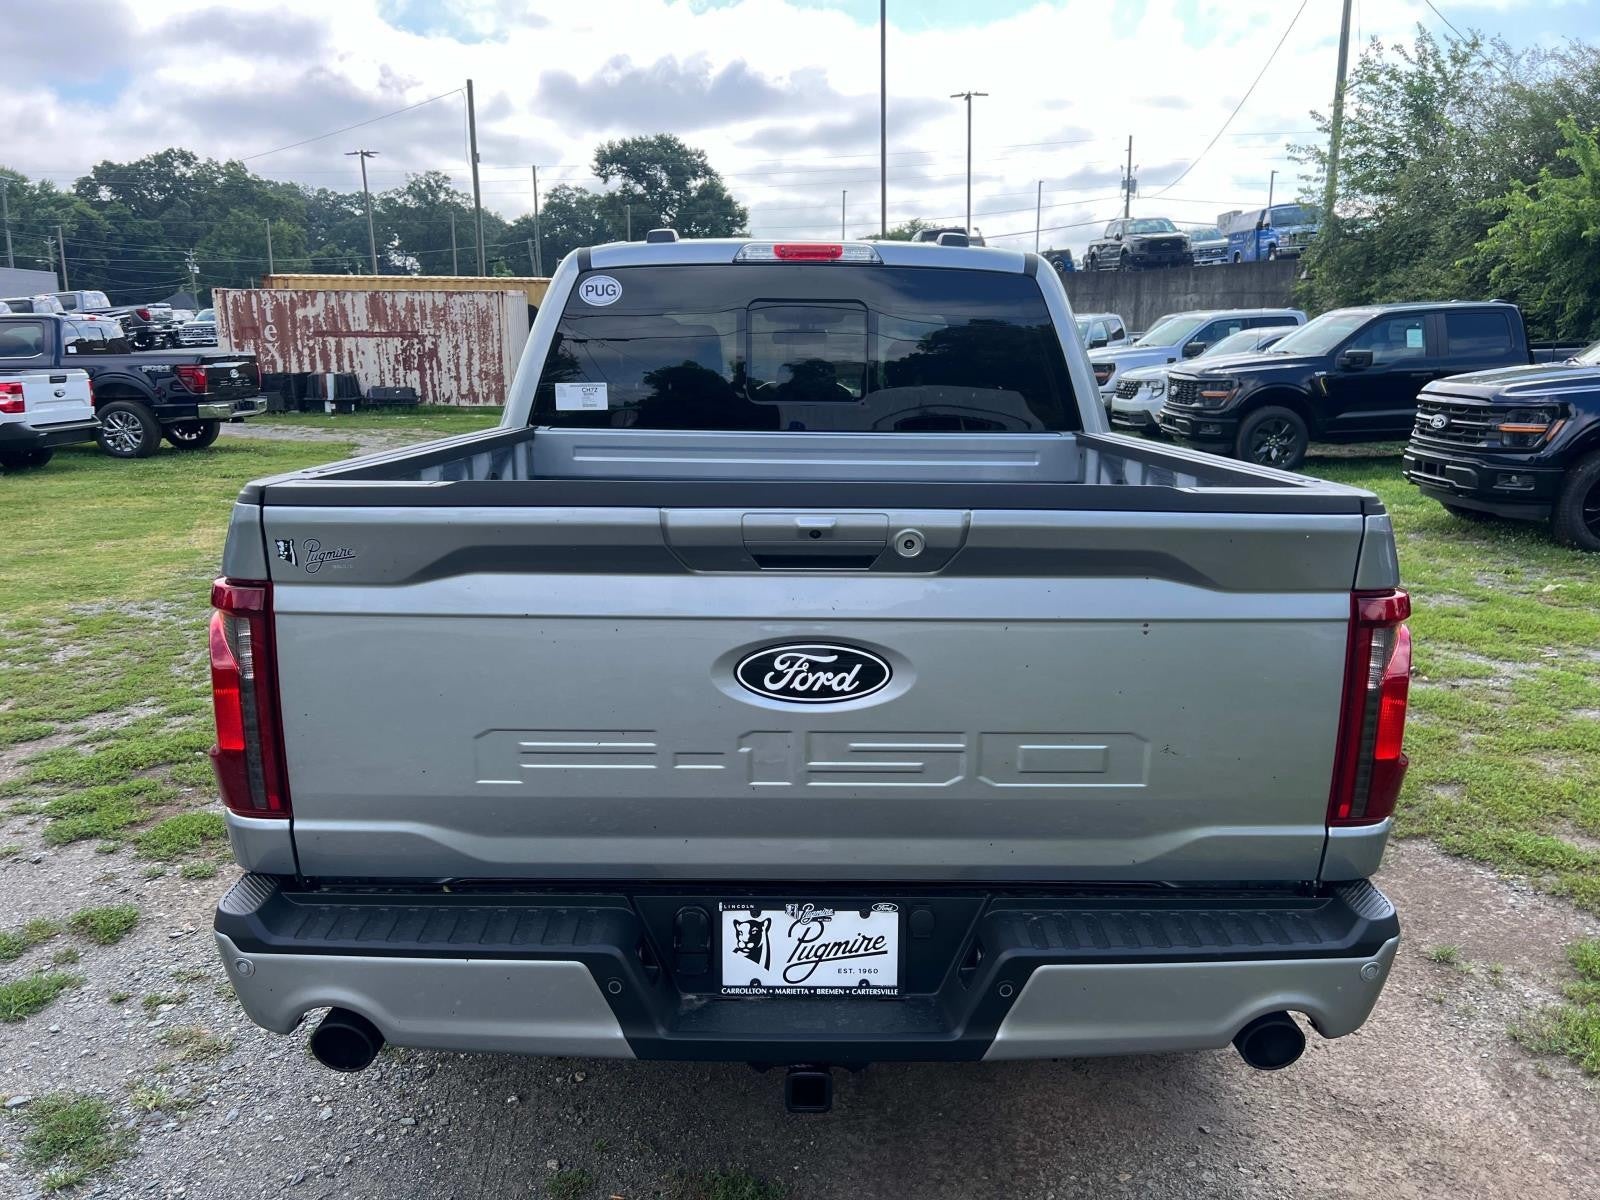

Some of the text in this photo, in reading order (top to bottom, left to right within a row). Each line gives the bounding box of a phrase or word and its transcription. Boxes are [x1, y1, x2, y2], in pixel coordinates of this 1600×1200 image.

[585, 284, 617, 297] PUG
[303, 538, 357, 574] Pugmire
[763, 651, 863, 695] Ford
[474, 728, 1151, 788] F-150
[783, 919, 889, 985] Pugmire
[721, 987, 767, 995] CARROLLTON
